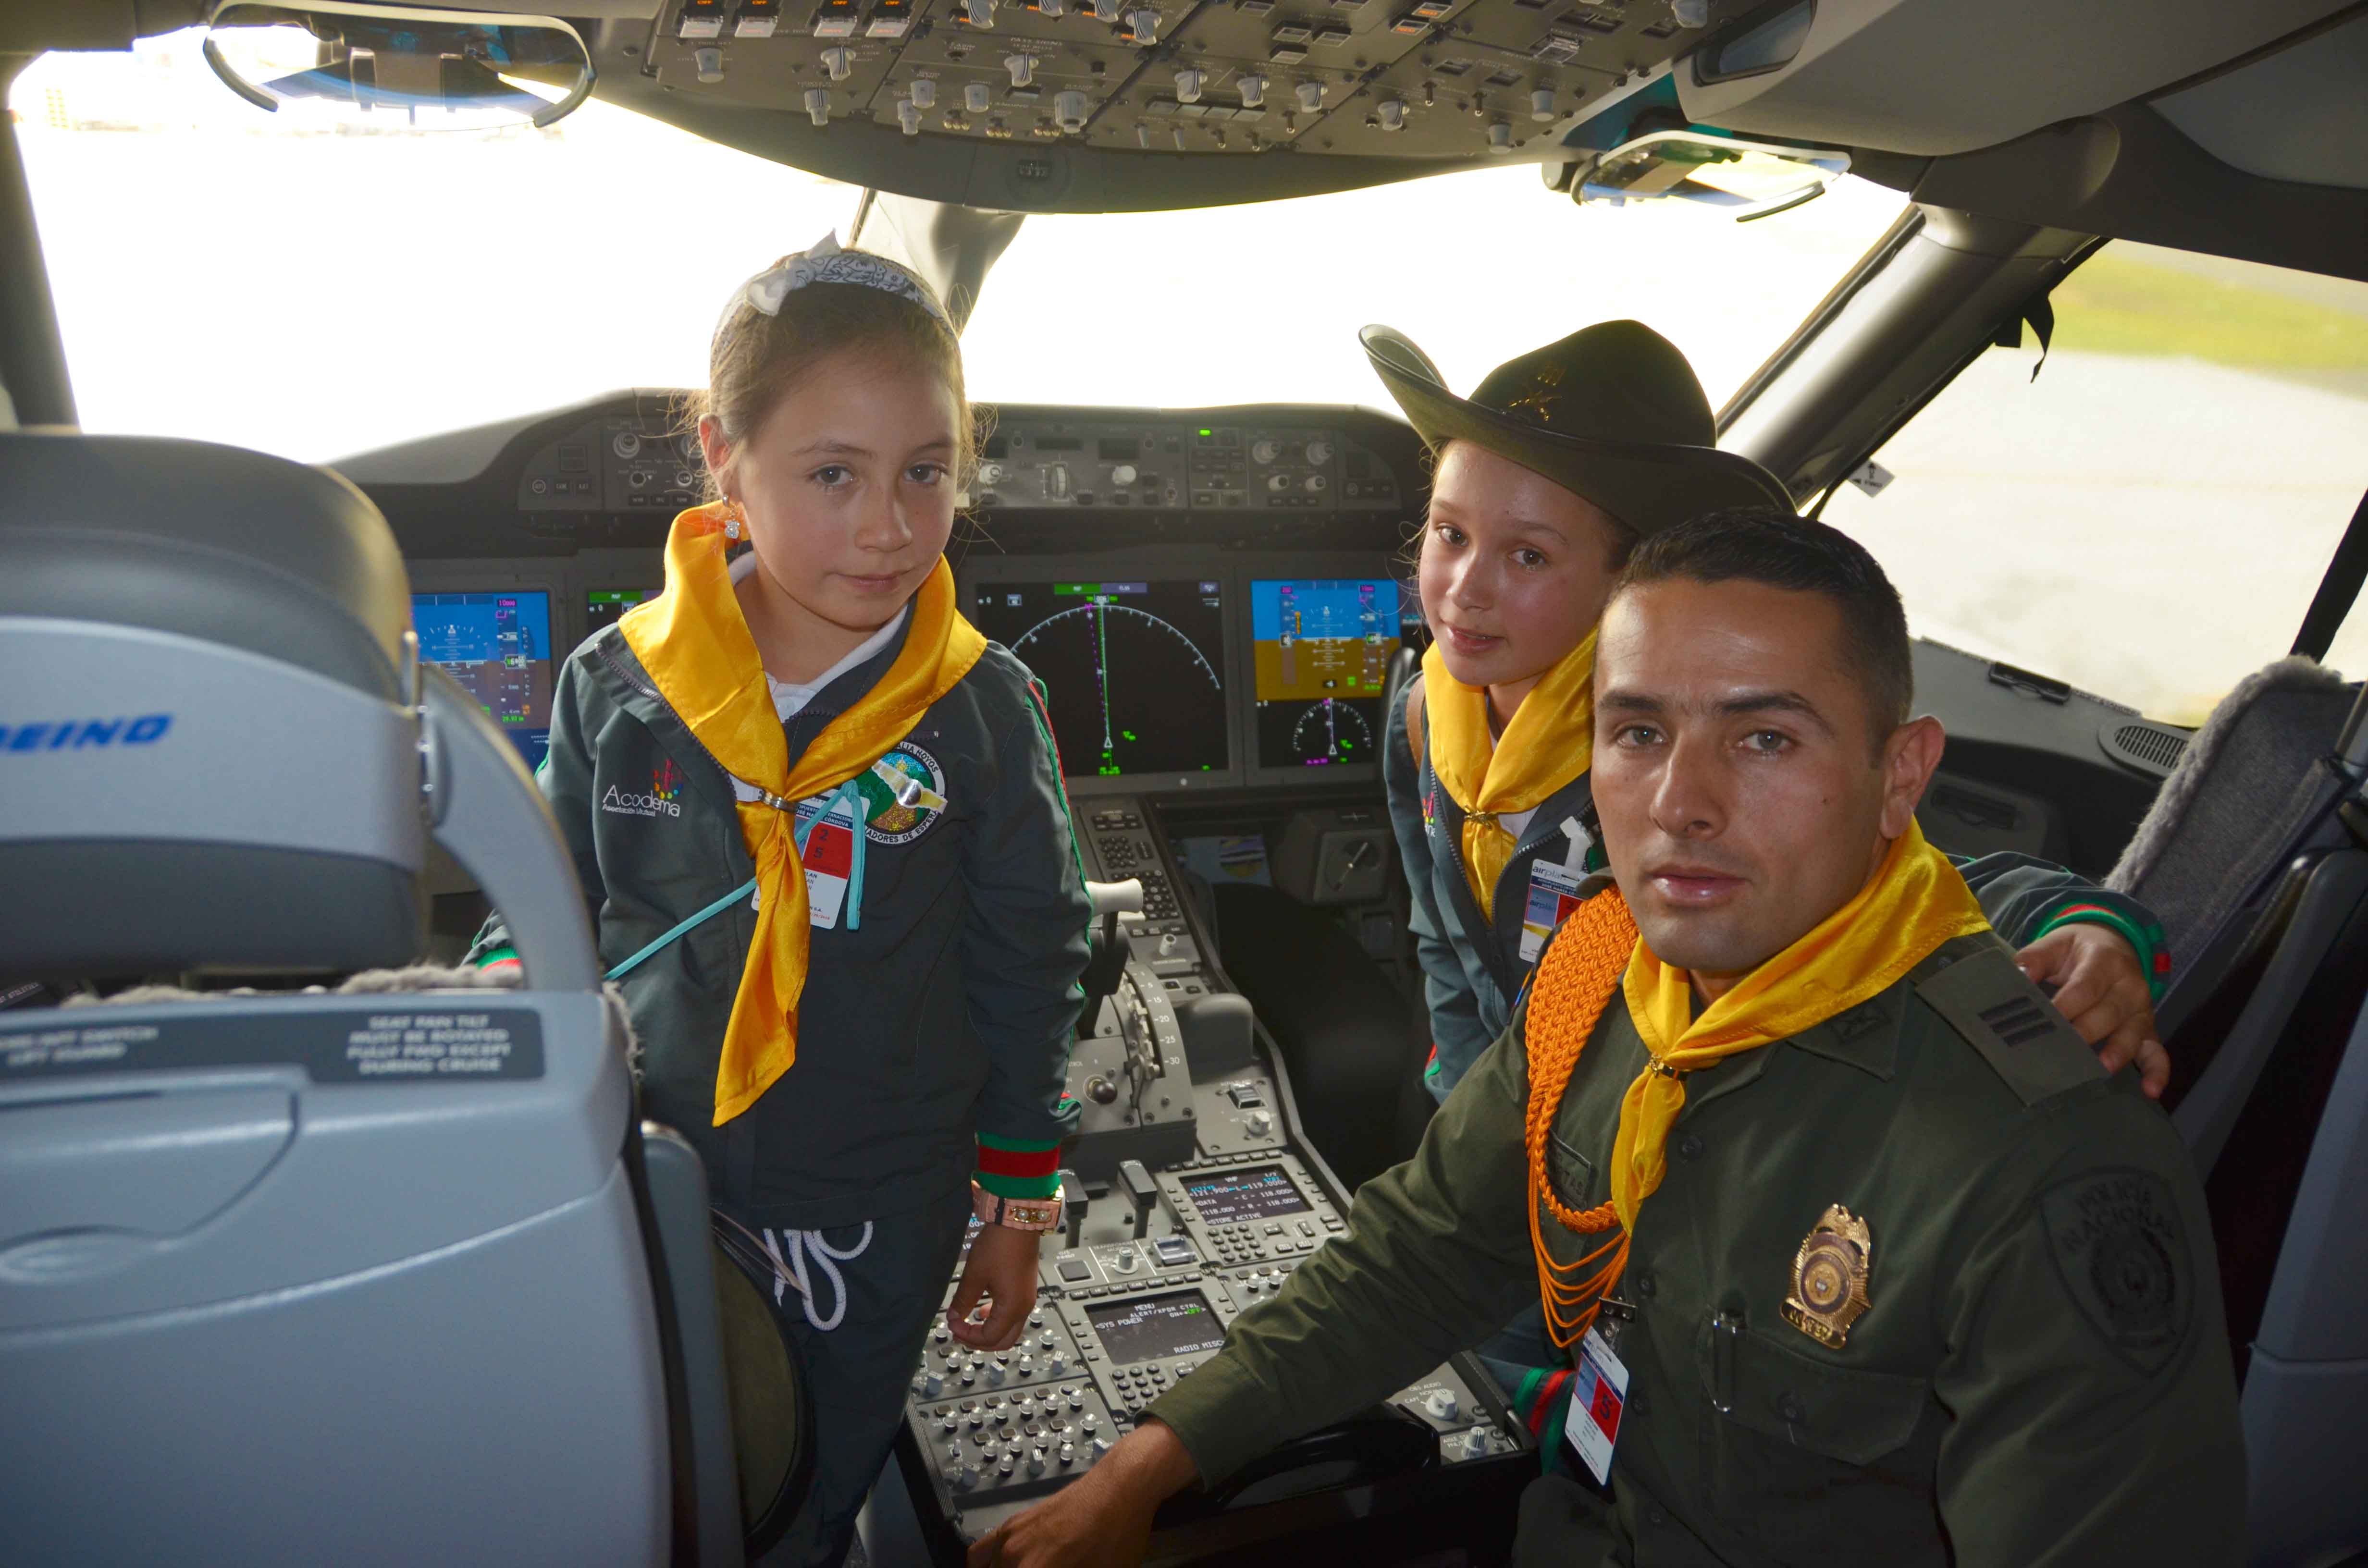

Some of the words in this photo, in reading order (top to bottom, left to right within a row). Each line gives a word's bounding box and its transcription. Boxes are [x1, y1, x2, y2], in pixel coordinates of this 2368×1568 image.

[0, 713, 174, 752] EING
[916, 750, 938, 772] HOYOS
[603, 784, 680, 817] Acodema
[824, 817, 849, 827] CÓRDOVA
[819, 829, 829, 840] 2
[865, 827, 899, 843] ADORES
[902, 833, 913, 841] DE
[814, 847, 823, 858] 5
[1236, 1212, 1262, 1221] ACTIVE
[1130, 1306, 1176, 1318] ALERT/XPDR
[1134, 1303, 1155, 1311] MENU
[1117, 1317, 1144, 1326] POWER
[1173, 1345, 1200, 1354] RADIO
